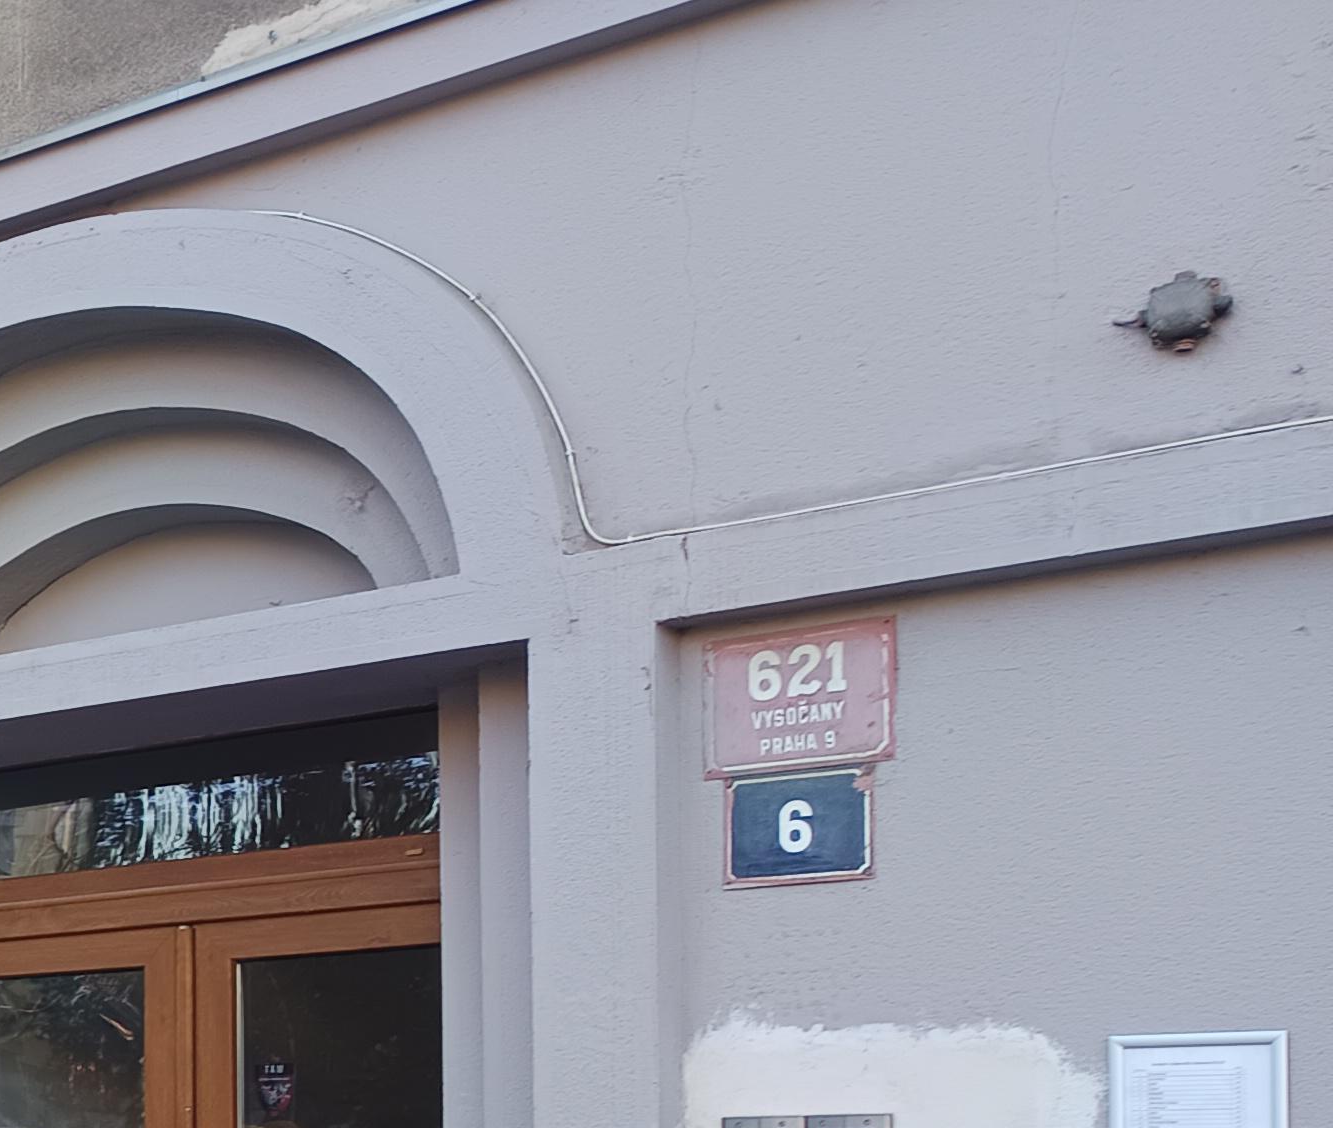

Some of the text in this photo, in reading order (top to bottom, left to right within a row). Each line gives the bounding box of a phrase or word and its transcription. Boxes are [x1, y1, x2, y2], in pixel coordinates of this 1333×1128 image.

[748, 641, 848, 701] 621
[751, 701, 846, 730] VYSOČANY
[760, 730, 837, 756] PRAHA 9
[778, 799, 814, 853] 6
